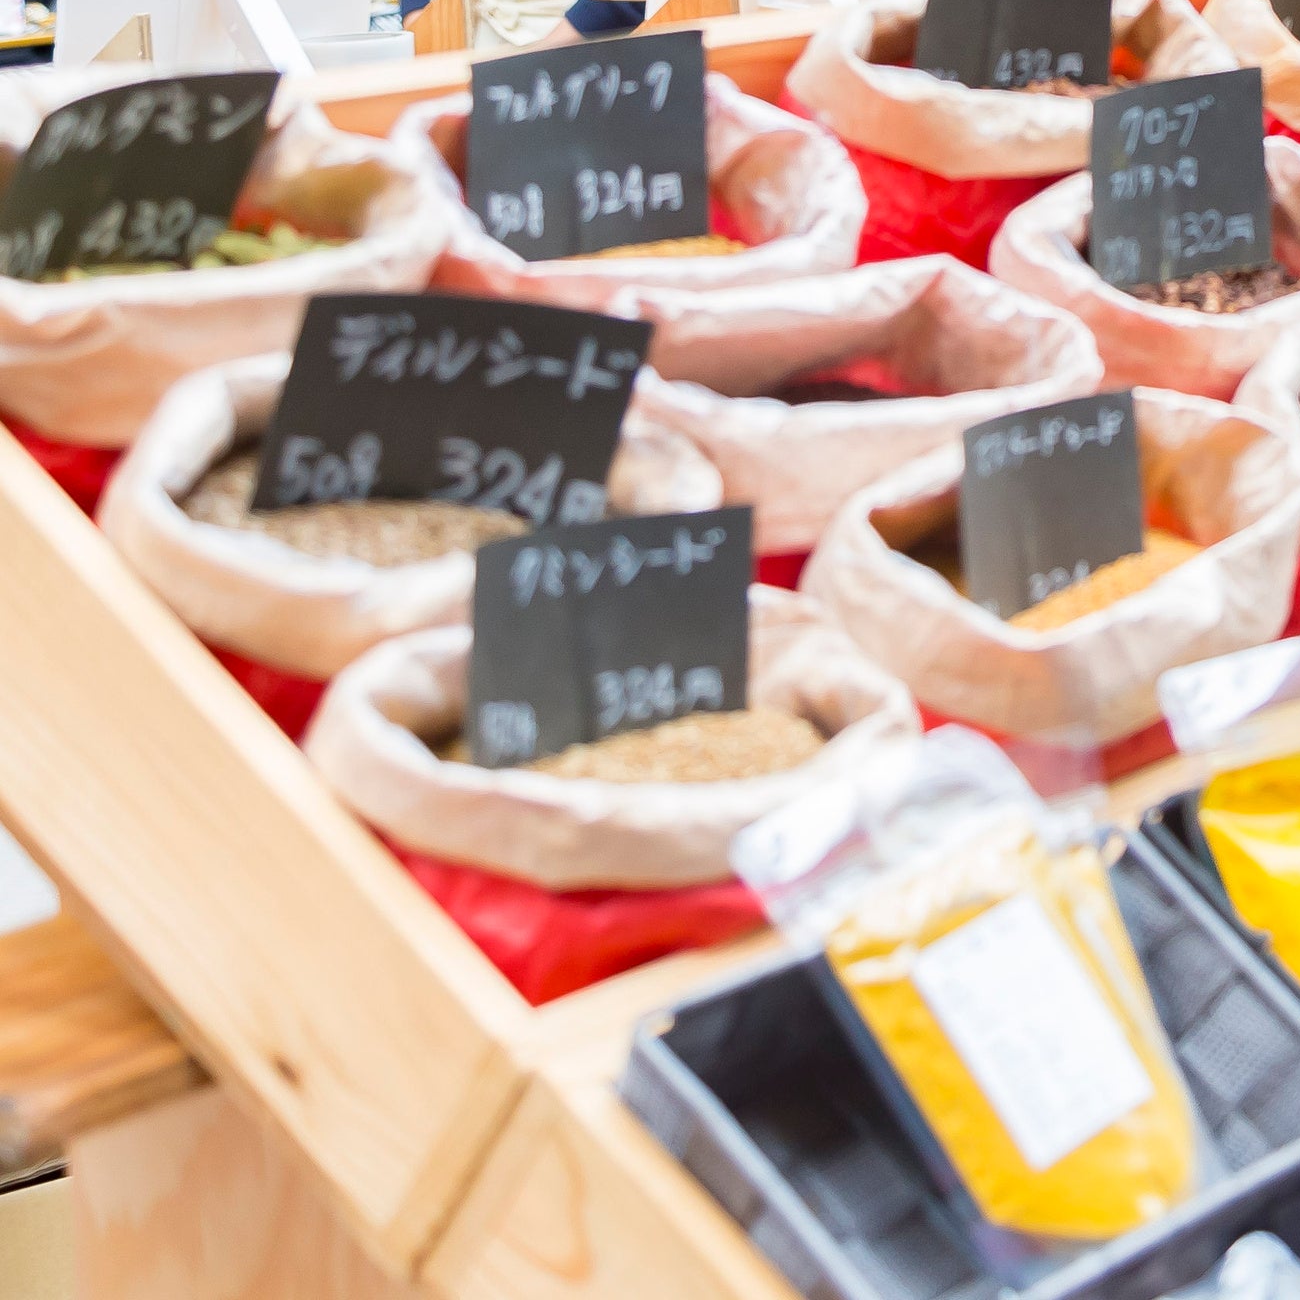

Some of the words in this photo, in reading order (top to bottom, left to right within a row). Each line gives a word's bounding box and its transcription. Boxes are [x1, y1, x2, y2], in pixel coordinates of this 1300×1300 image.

[329, 311, 641, 401] ディルシード
